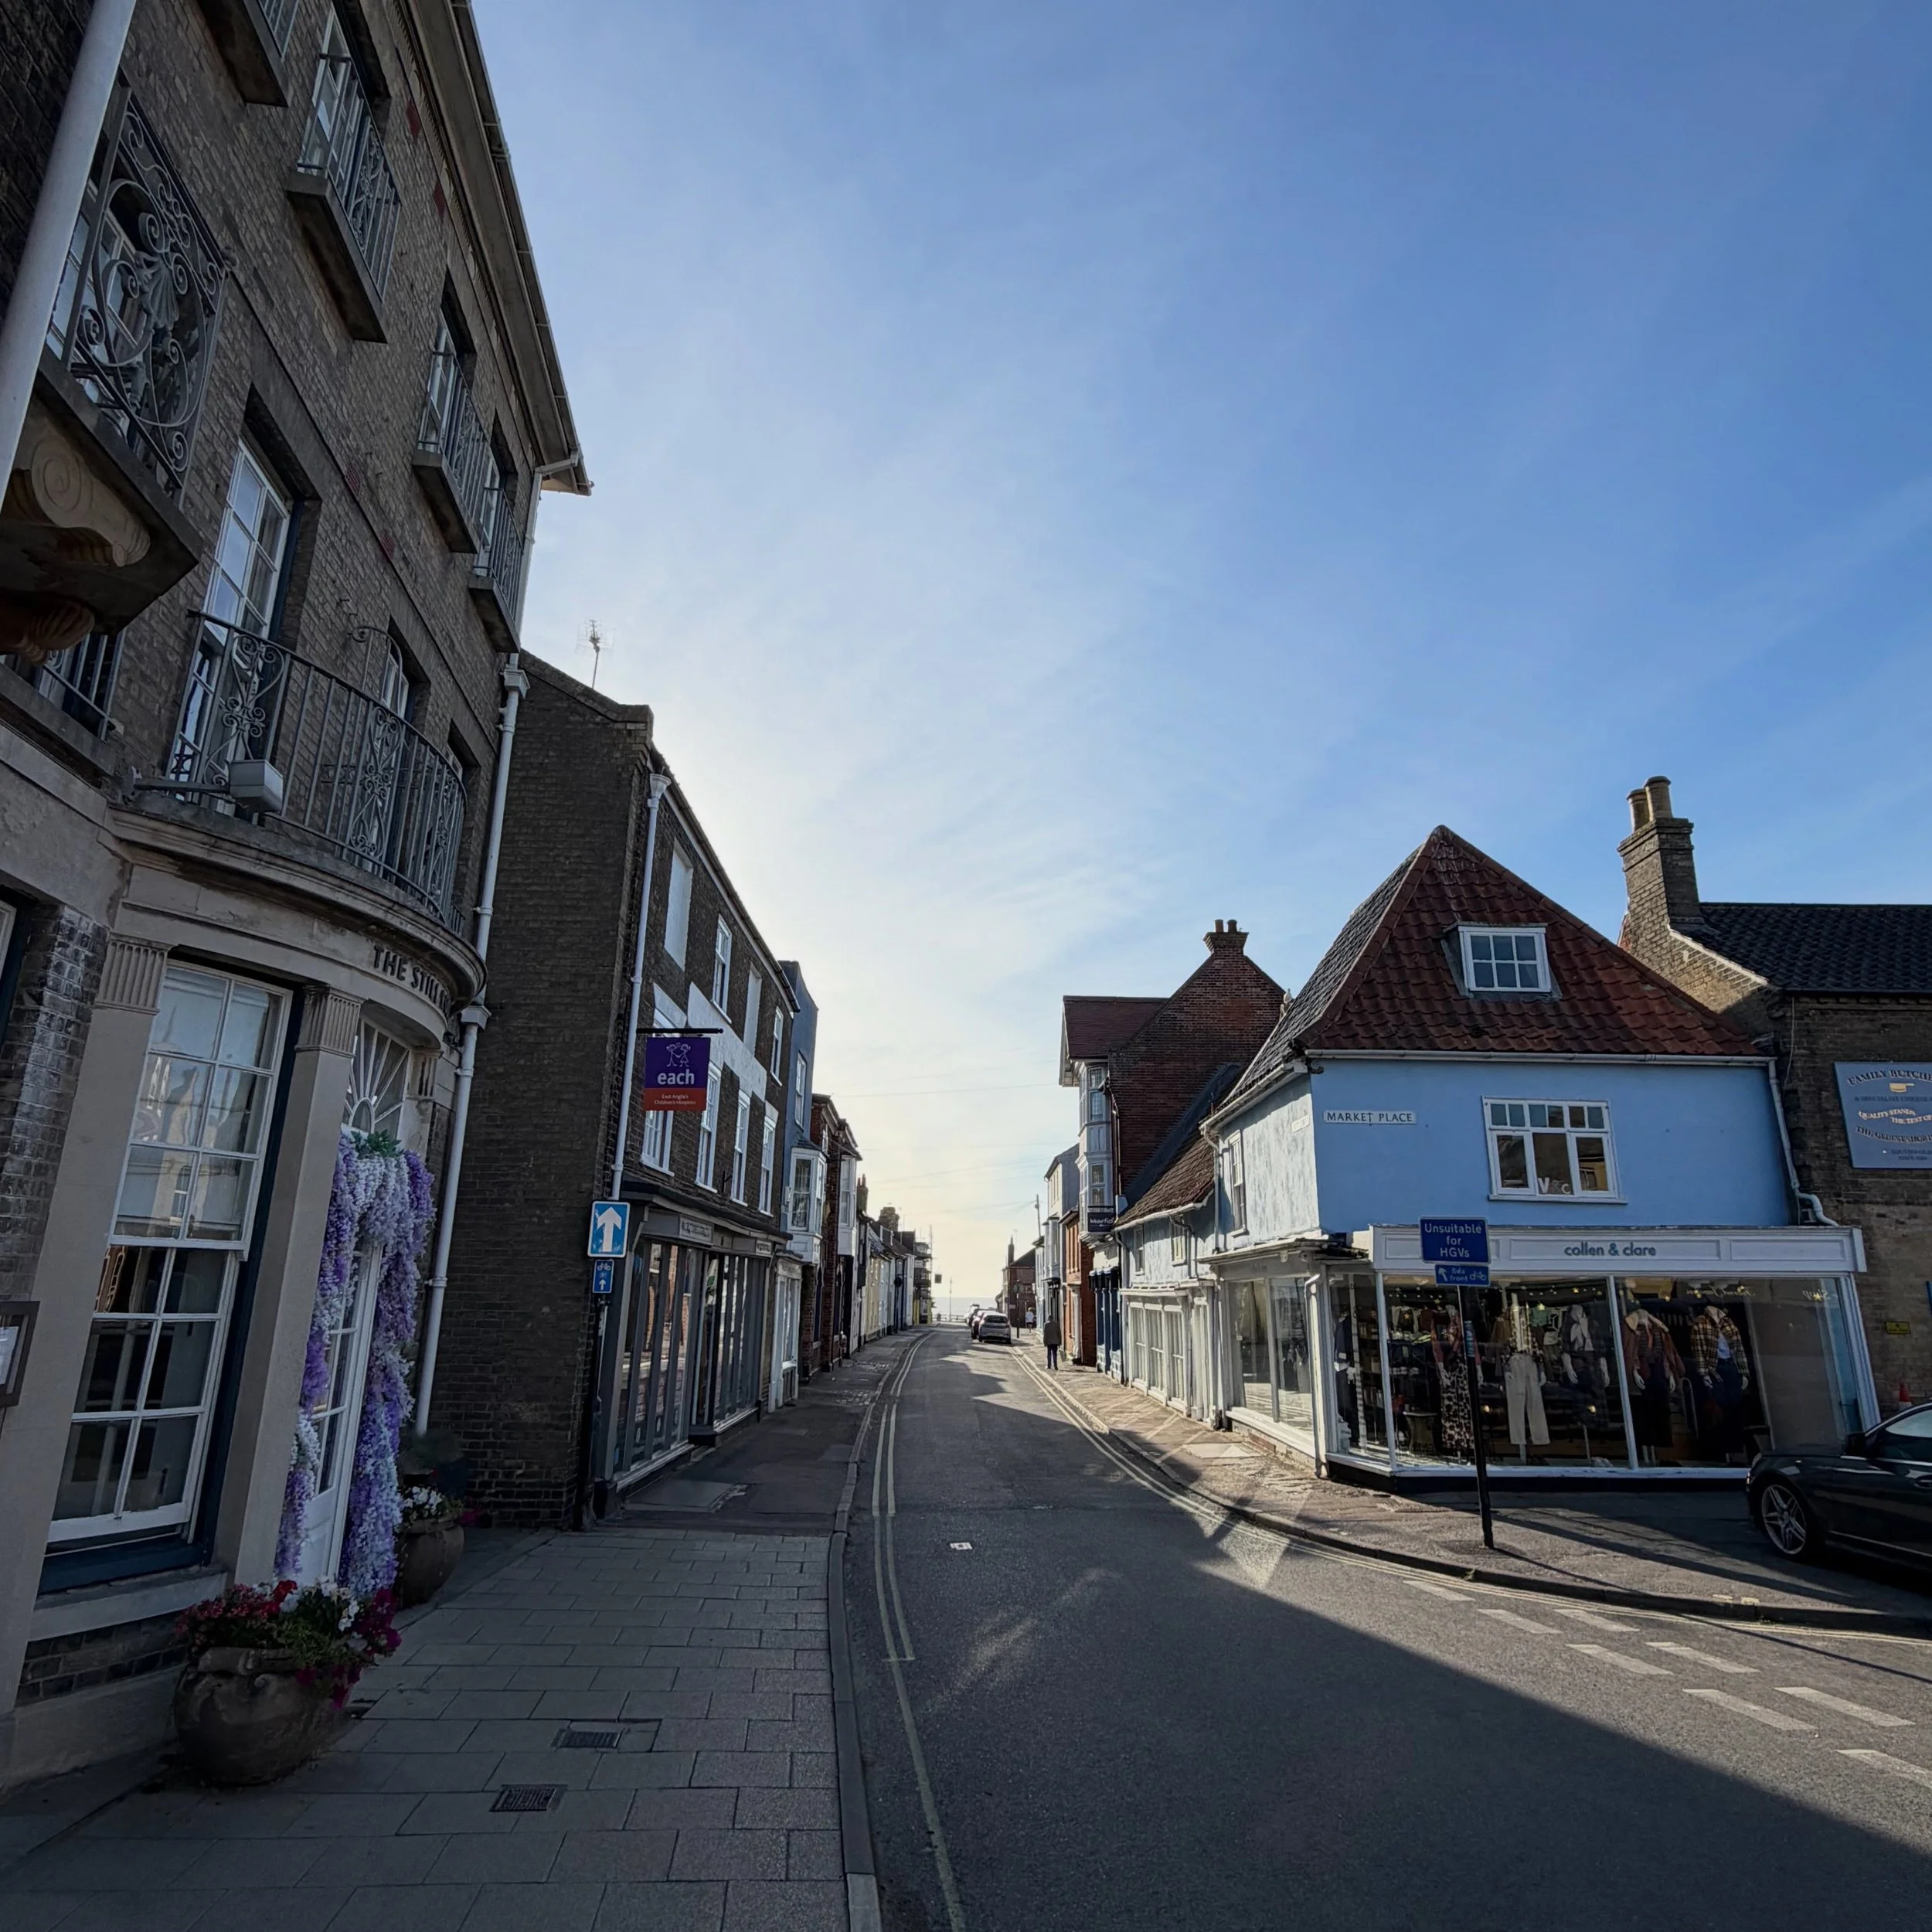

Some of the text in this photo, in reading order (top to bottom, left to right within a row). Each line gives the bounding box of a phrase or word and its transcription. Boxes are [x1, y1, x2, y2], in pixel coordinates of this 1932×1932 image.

[374, 945, 407, 981] THE
[410, 966, 439, 1005] STILL
[658, 1069, 695, 1085] each
[1847, 1070, 1887, 1086] FAMILY
[1327, 1112, 1413, 1122] MARKET PLACE
[1859, 1111, 1889, 1120] QUALITY
[1424, 1223, 1481, 1233] Unsuitable
[1446, 1236, 1461, 1245] for
[1440, 1247, 1470, 1257] HGVs
[1564, 1240, 1656, 1256] collen & clare
